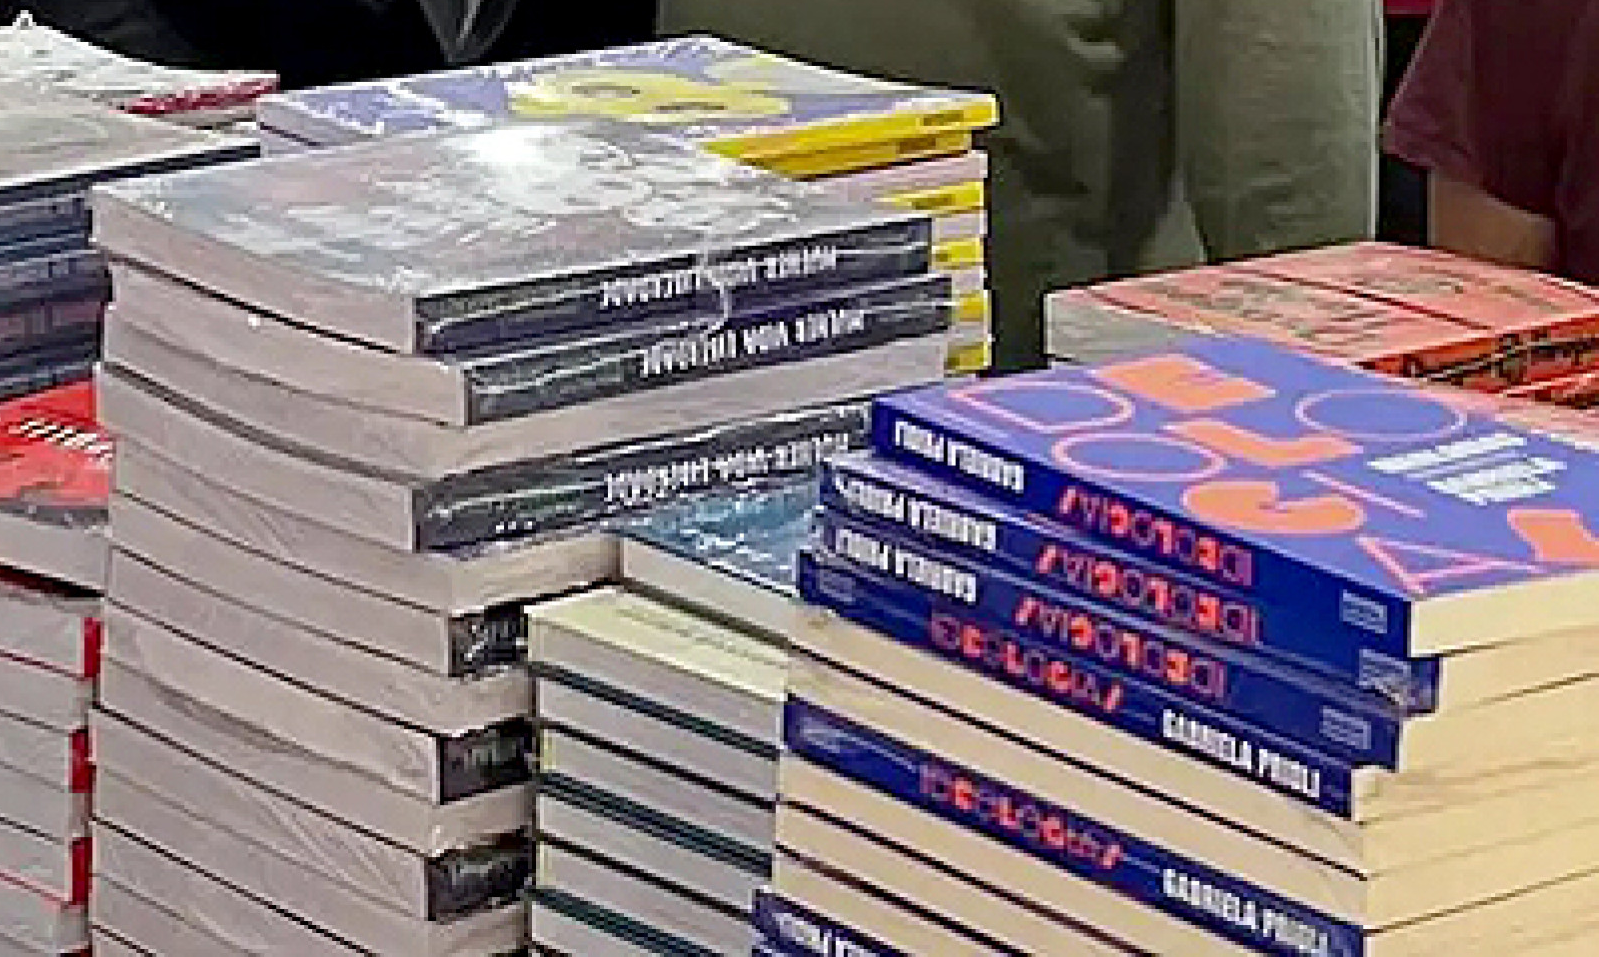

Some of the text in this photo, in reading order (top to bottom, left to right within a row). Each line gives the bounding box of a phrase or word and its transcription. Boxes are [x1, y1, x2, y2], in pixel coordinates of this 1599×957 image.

[638, 308, 865, 375] MULHER VIDA LIBERDADE
[894, 420, 945, 463] PRIOLI
[946, 439, 1025, 493] GABRIELA
[906, 496, 997, 554] GABRIELA
[893, 548, 978, 603] GABRIELA
[1160, 707, 1255, 772] GABRIELA
[1257, 746, 1323, 799] PRIOLI
[1161, 865, 1259, 932] GABRIELA
[1259, 905, 1331, 956] PRIOLI
